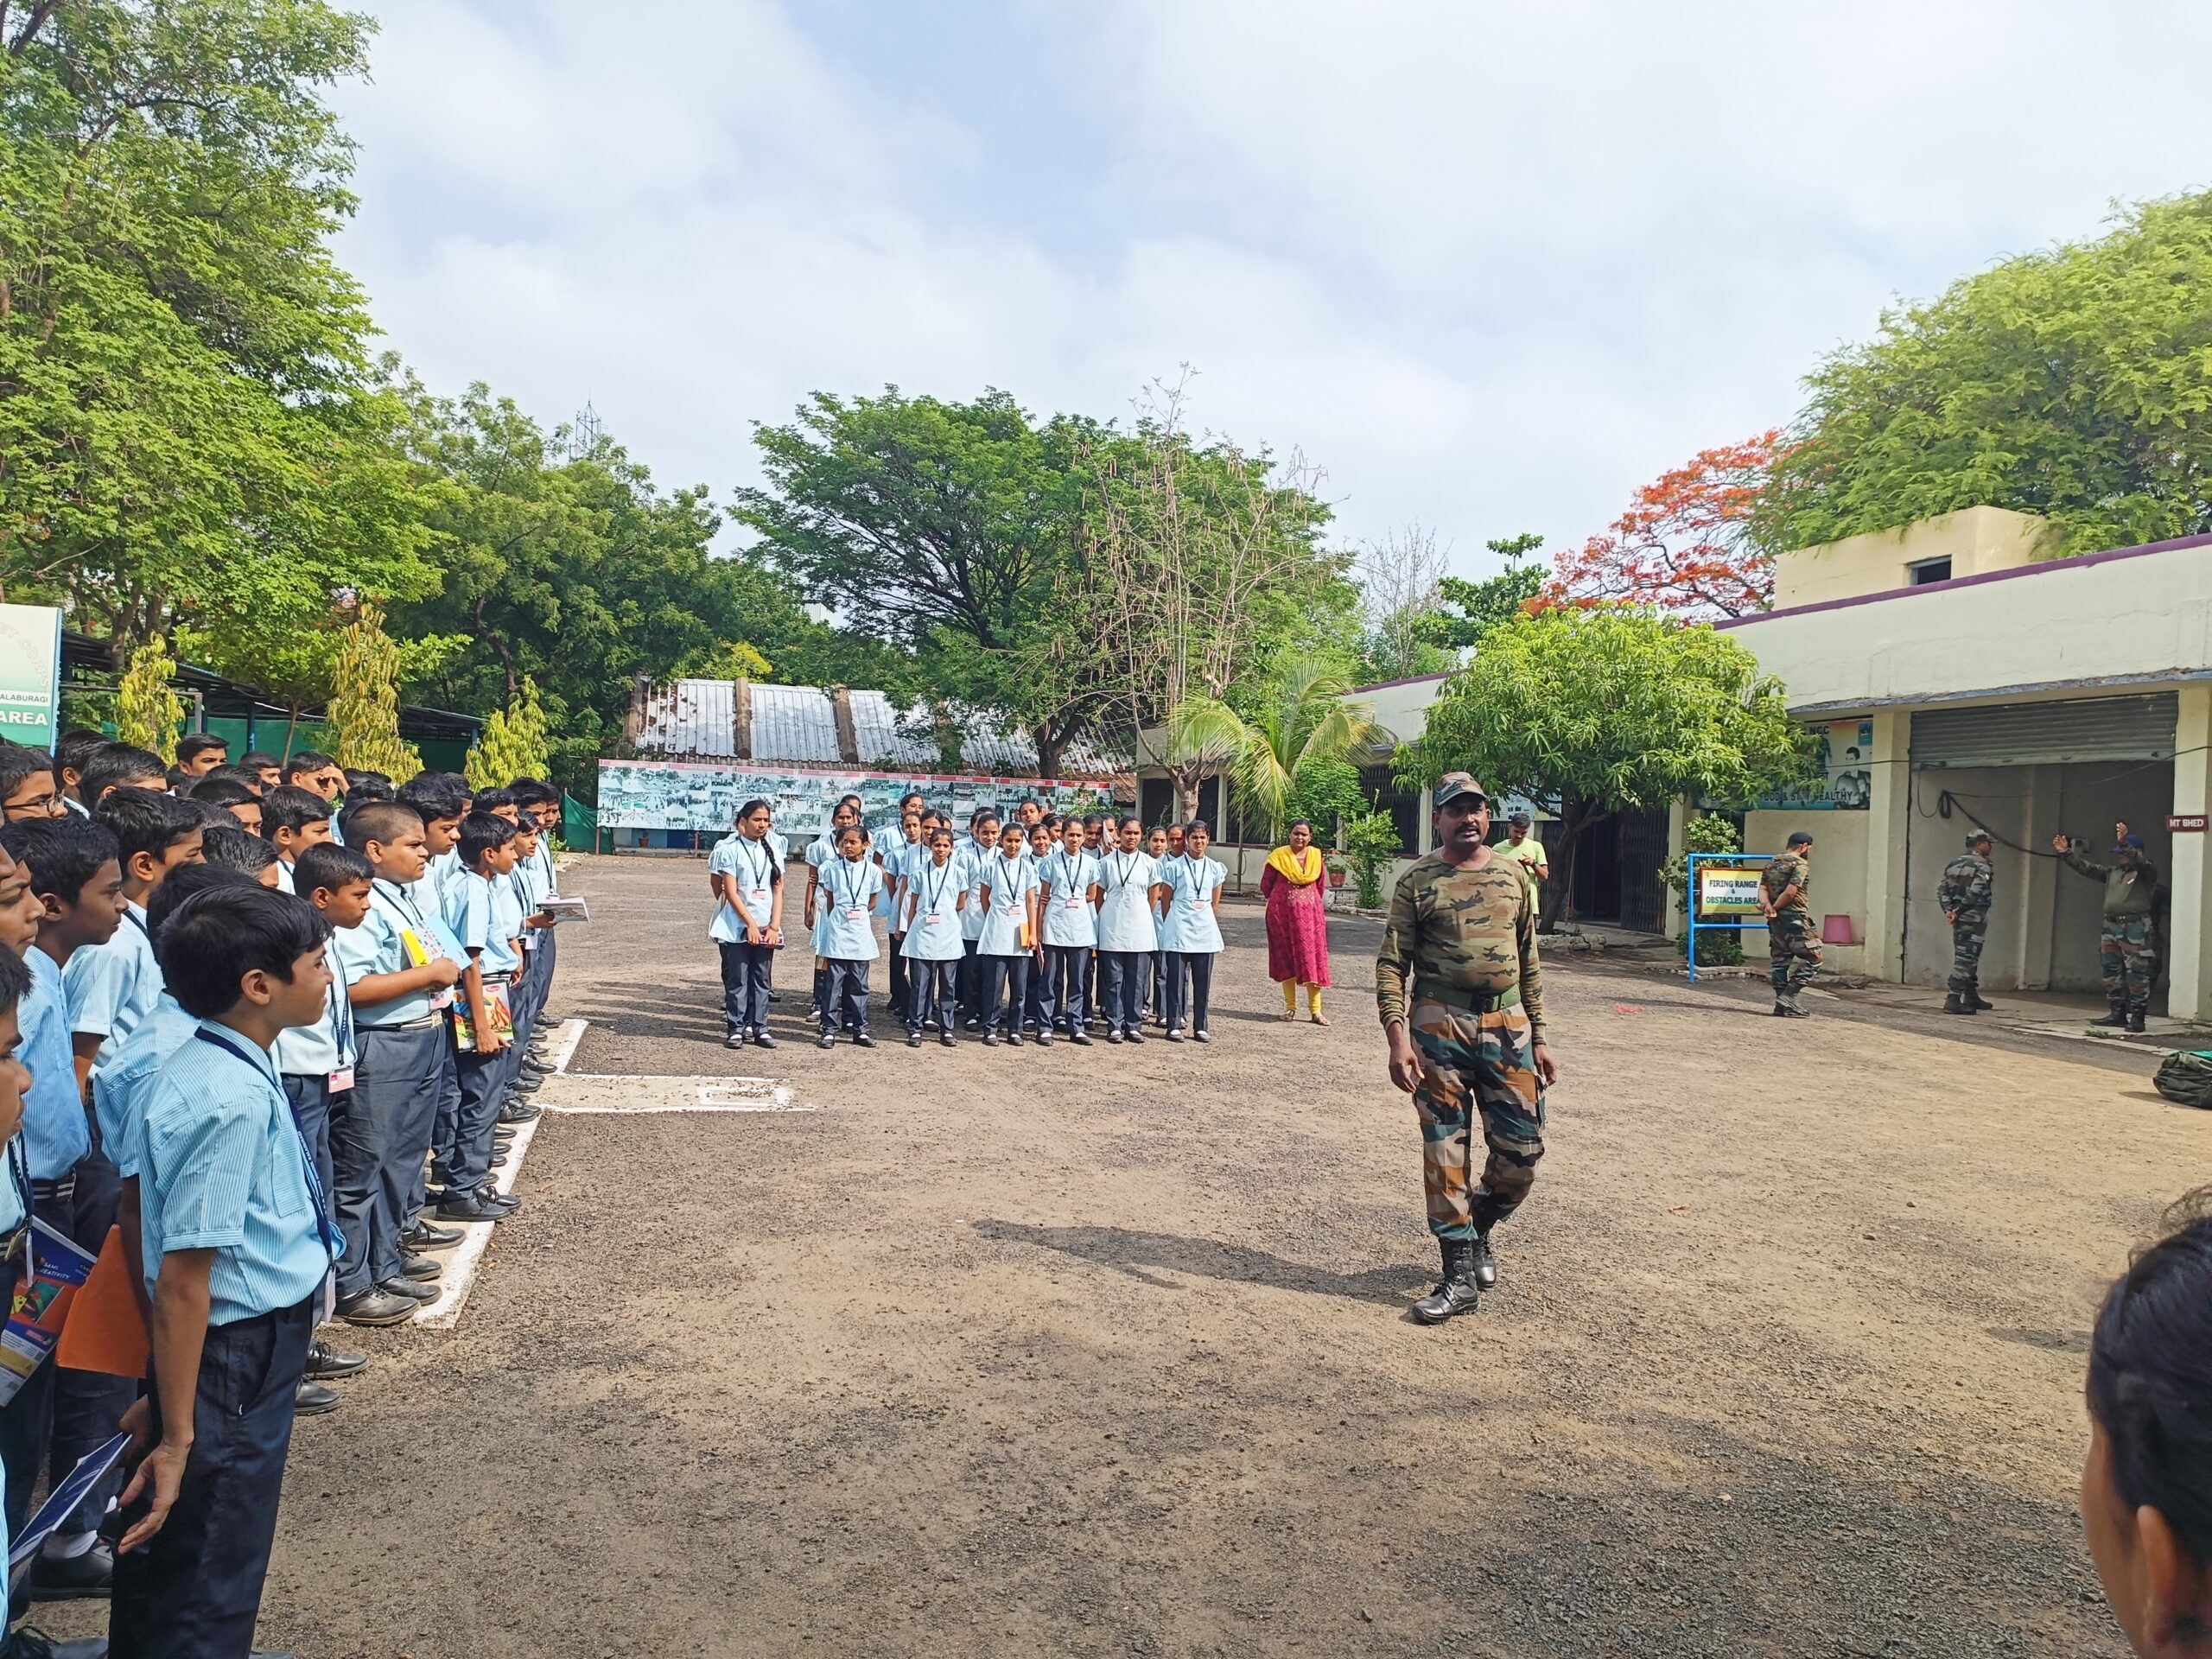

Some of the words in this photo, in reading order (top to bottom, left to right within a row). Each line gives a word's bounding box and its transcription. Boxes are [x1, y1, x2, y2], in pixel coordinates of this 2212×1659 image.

[1808, 726, 1829, 735] NCC
[2182, 818, 2204, 828] SHED
[1709, 880, 1734, 888] FIRING
[1735, 880, 1758, 888] RANGE
[1706, 896, 1743, 905] OBSTACLES
